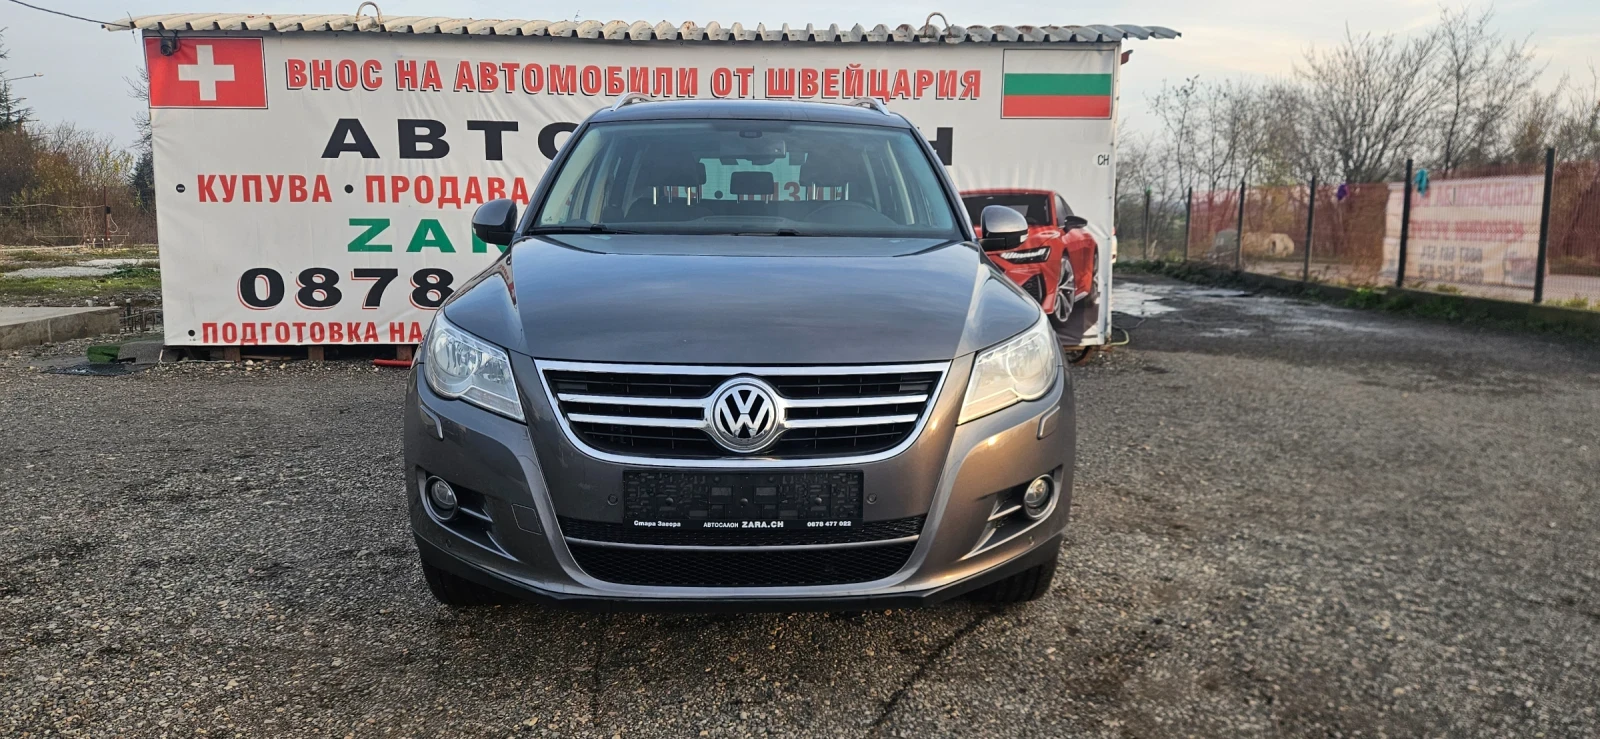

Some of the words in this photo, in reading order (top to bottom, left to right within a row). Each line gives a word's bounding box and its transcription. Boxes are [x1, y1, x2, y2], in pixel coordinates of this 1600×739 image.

[285, 58, 383, 92] ВНОС
[394, 59, 443, 92] НА
[453, 60, 698, 97] АВТОМОБИЛИ
[711, 67, 754, 98] ОТ
[765, 63, 982, 102] ШВЕЙЦАРИЯ
[197, 174, 333, 203] КУПУВА
[365, 175, 531, 209] ПРОДАВА
[237, 267, 456, 310] 0878
[202, 322, 379, 345] ПОДГОТОВКА
[389, 322, 424, 343] НА
[741, 520, 784, 528] ZARA.CH
